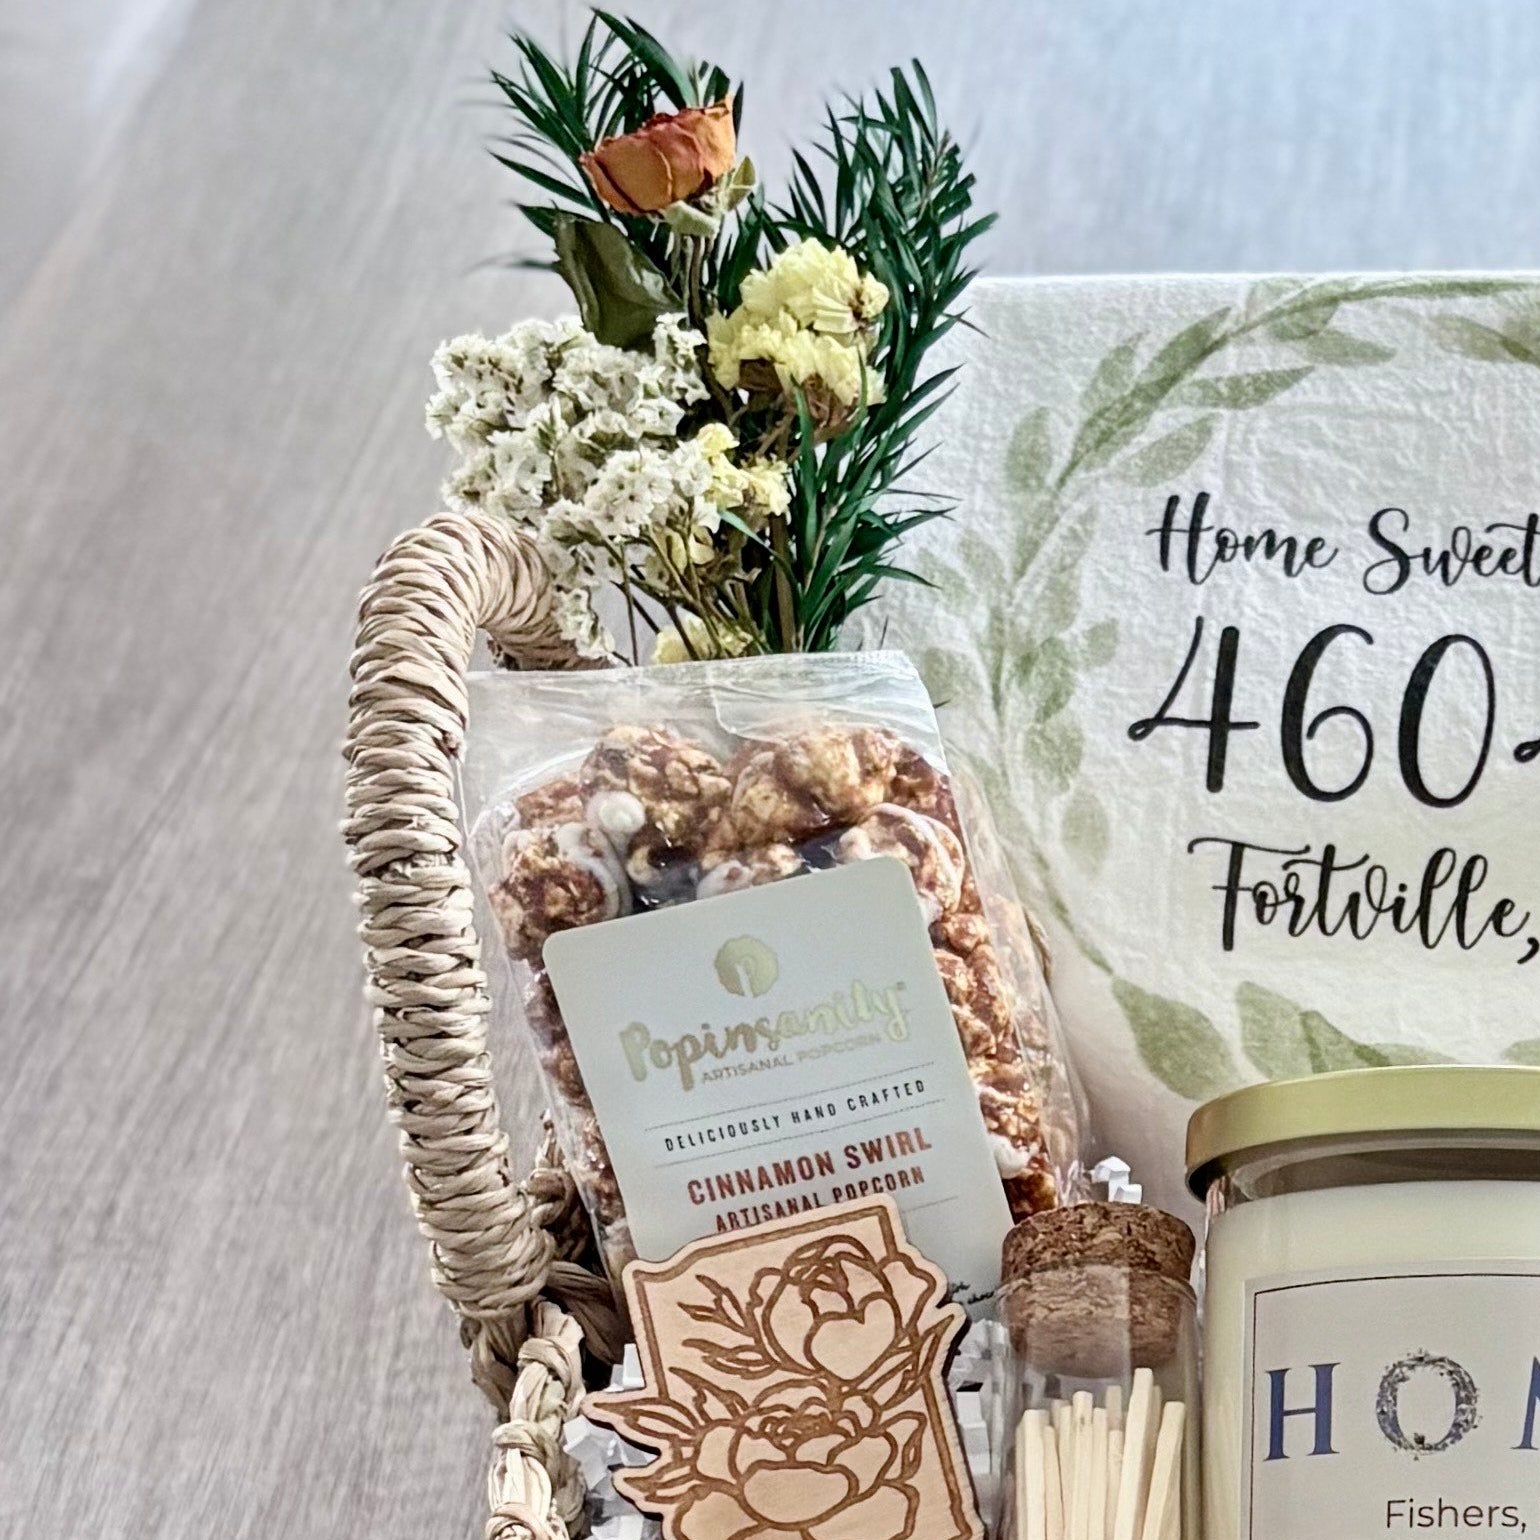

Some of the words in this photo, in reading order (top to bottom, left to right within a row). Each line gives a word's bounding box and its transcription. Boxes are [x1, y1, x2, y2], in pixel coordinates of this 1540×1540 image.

[1146, 491, 1339, 585] Home
[1187, 837, 1540, 965] Fortville,
[702, 1054, 794, 1084] ARTISANAL
[664, 1115, 781, 1152] DELICIOUSLY
[791, 1102, 837, 1125] HAND
[847, 1079, 926, 1111] CRAFTED
[687, 1151, 836, 1206] CINNAMON
[843, 1127, 932, 1170] SWIRL
[715, 1192, 824, 1233] ARTISANAL
[832, 1166, 925, 1204] POPCORN
[1386, 1498, 1528, 1534] Fishers,
